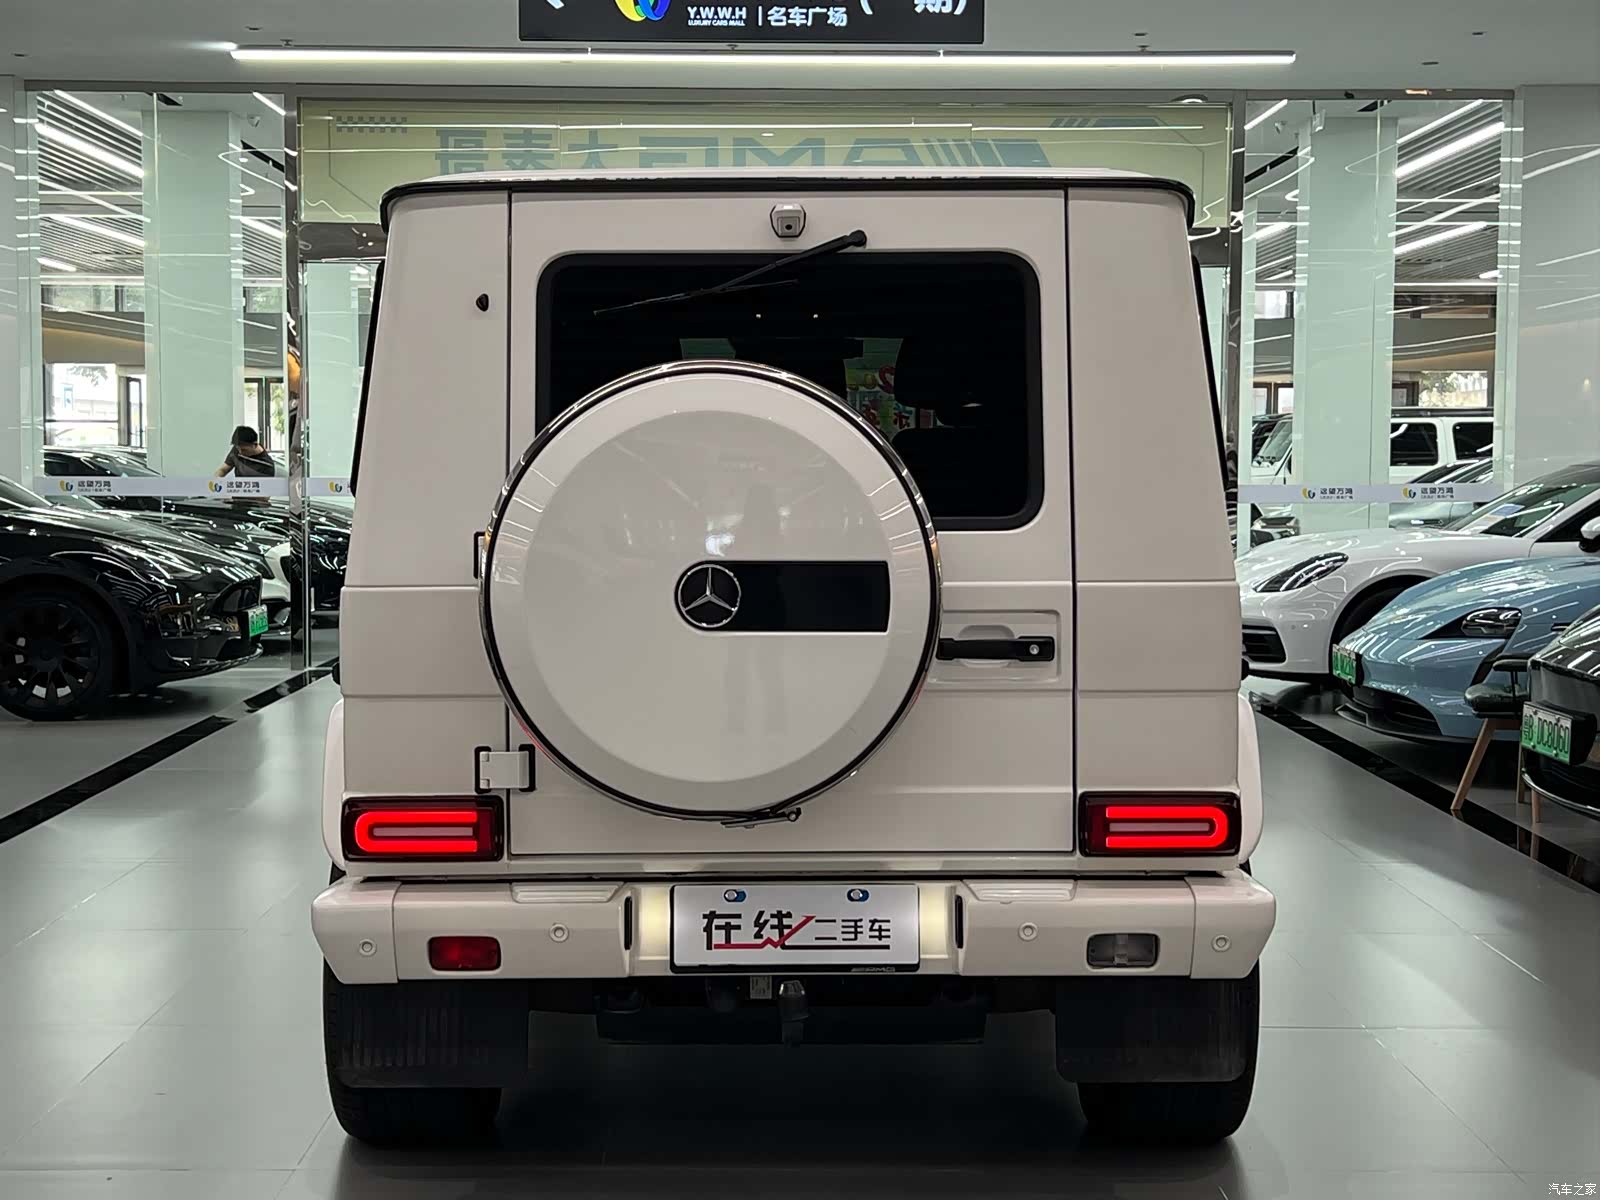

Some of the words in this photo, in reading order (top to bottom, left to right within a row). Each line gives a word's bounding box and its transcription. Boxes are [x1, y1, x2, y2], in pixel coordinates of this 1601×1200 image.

[687, 6, 747, 20] Y.W.W.H
[767, 6, 848, 27] 名车广场
